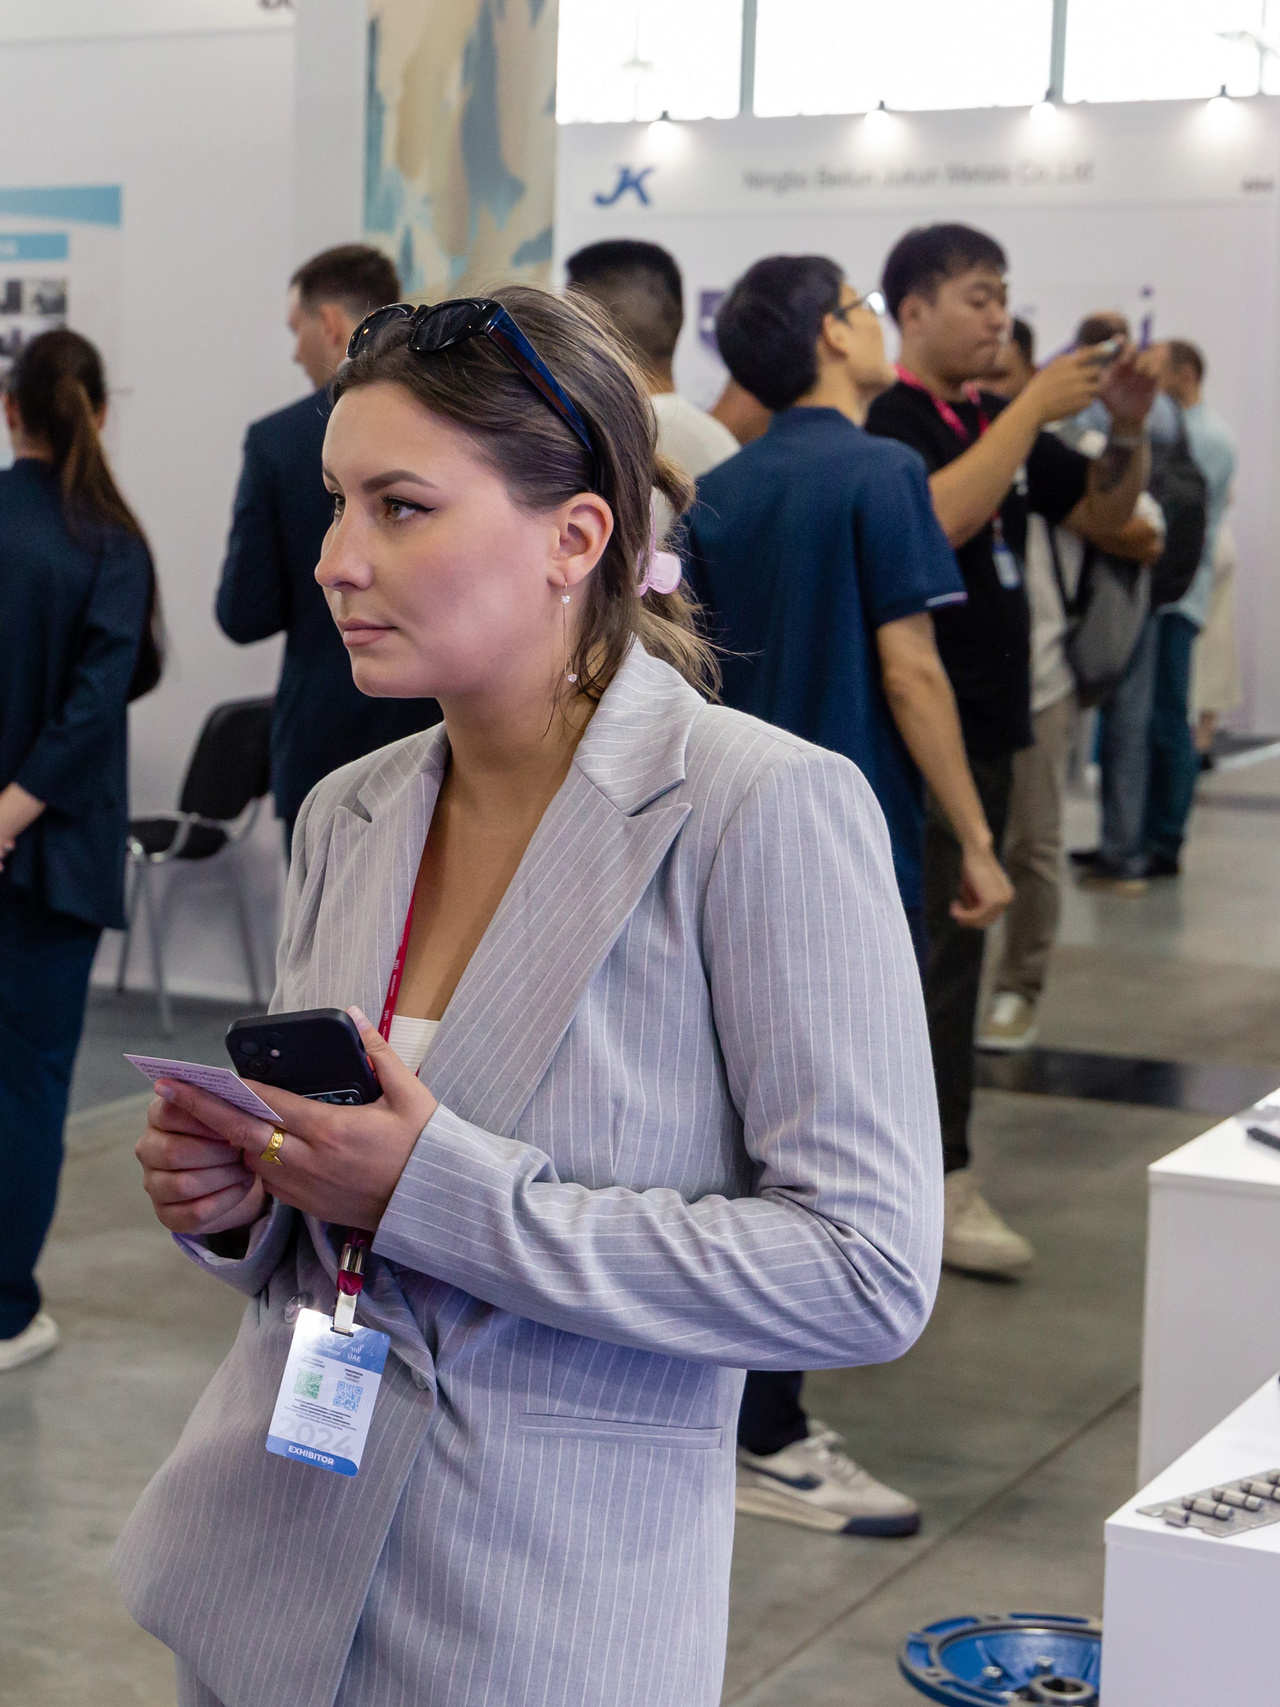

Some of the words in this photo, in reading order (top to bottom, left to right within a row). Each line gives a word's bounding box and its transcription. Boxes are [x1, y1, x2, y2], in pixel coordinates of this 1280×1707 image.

[346, 1353, 361, 1362] UAE
[275, 1413, 357, 1459] 2024
[287, 1444, 334, 1466] EXHIBITOR
